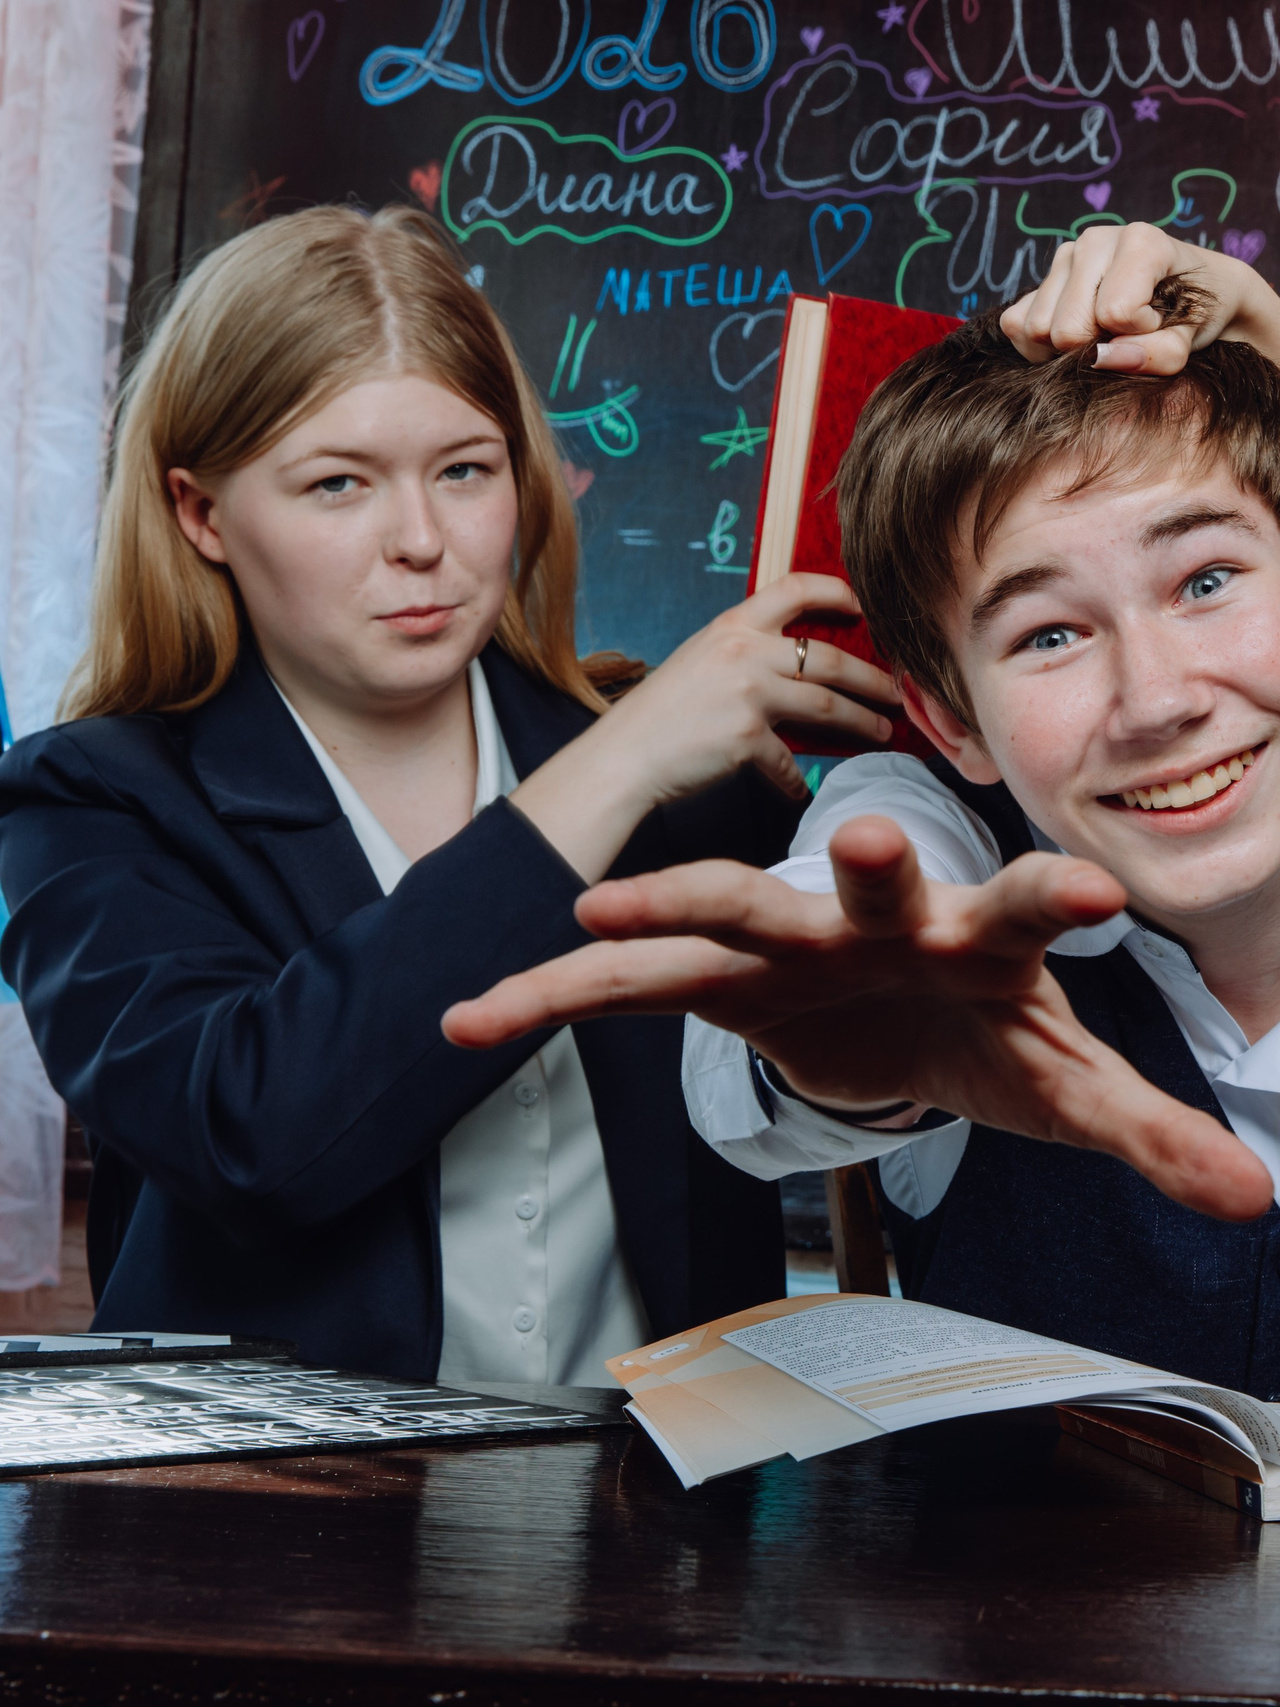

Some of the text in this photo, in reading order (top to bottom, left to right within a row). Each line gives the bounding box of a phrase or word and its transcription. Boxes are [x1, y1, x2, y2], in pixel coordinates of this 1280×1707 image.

[776, 61, 1110, 216] София
[462, 125, 715, 223] Диана
[65, 1360, 270, 1380] 2026
[214, 1374, 320, 1384] ROLL
[203, 1378, 370, 1396] WTF
[248, 1395, 389, 1408] SOUND
